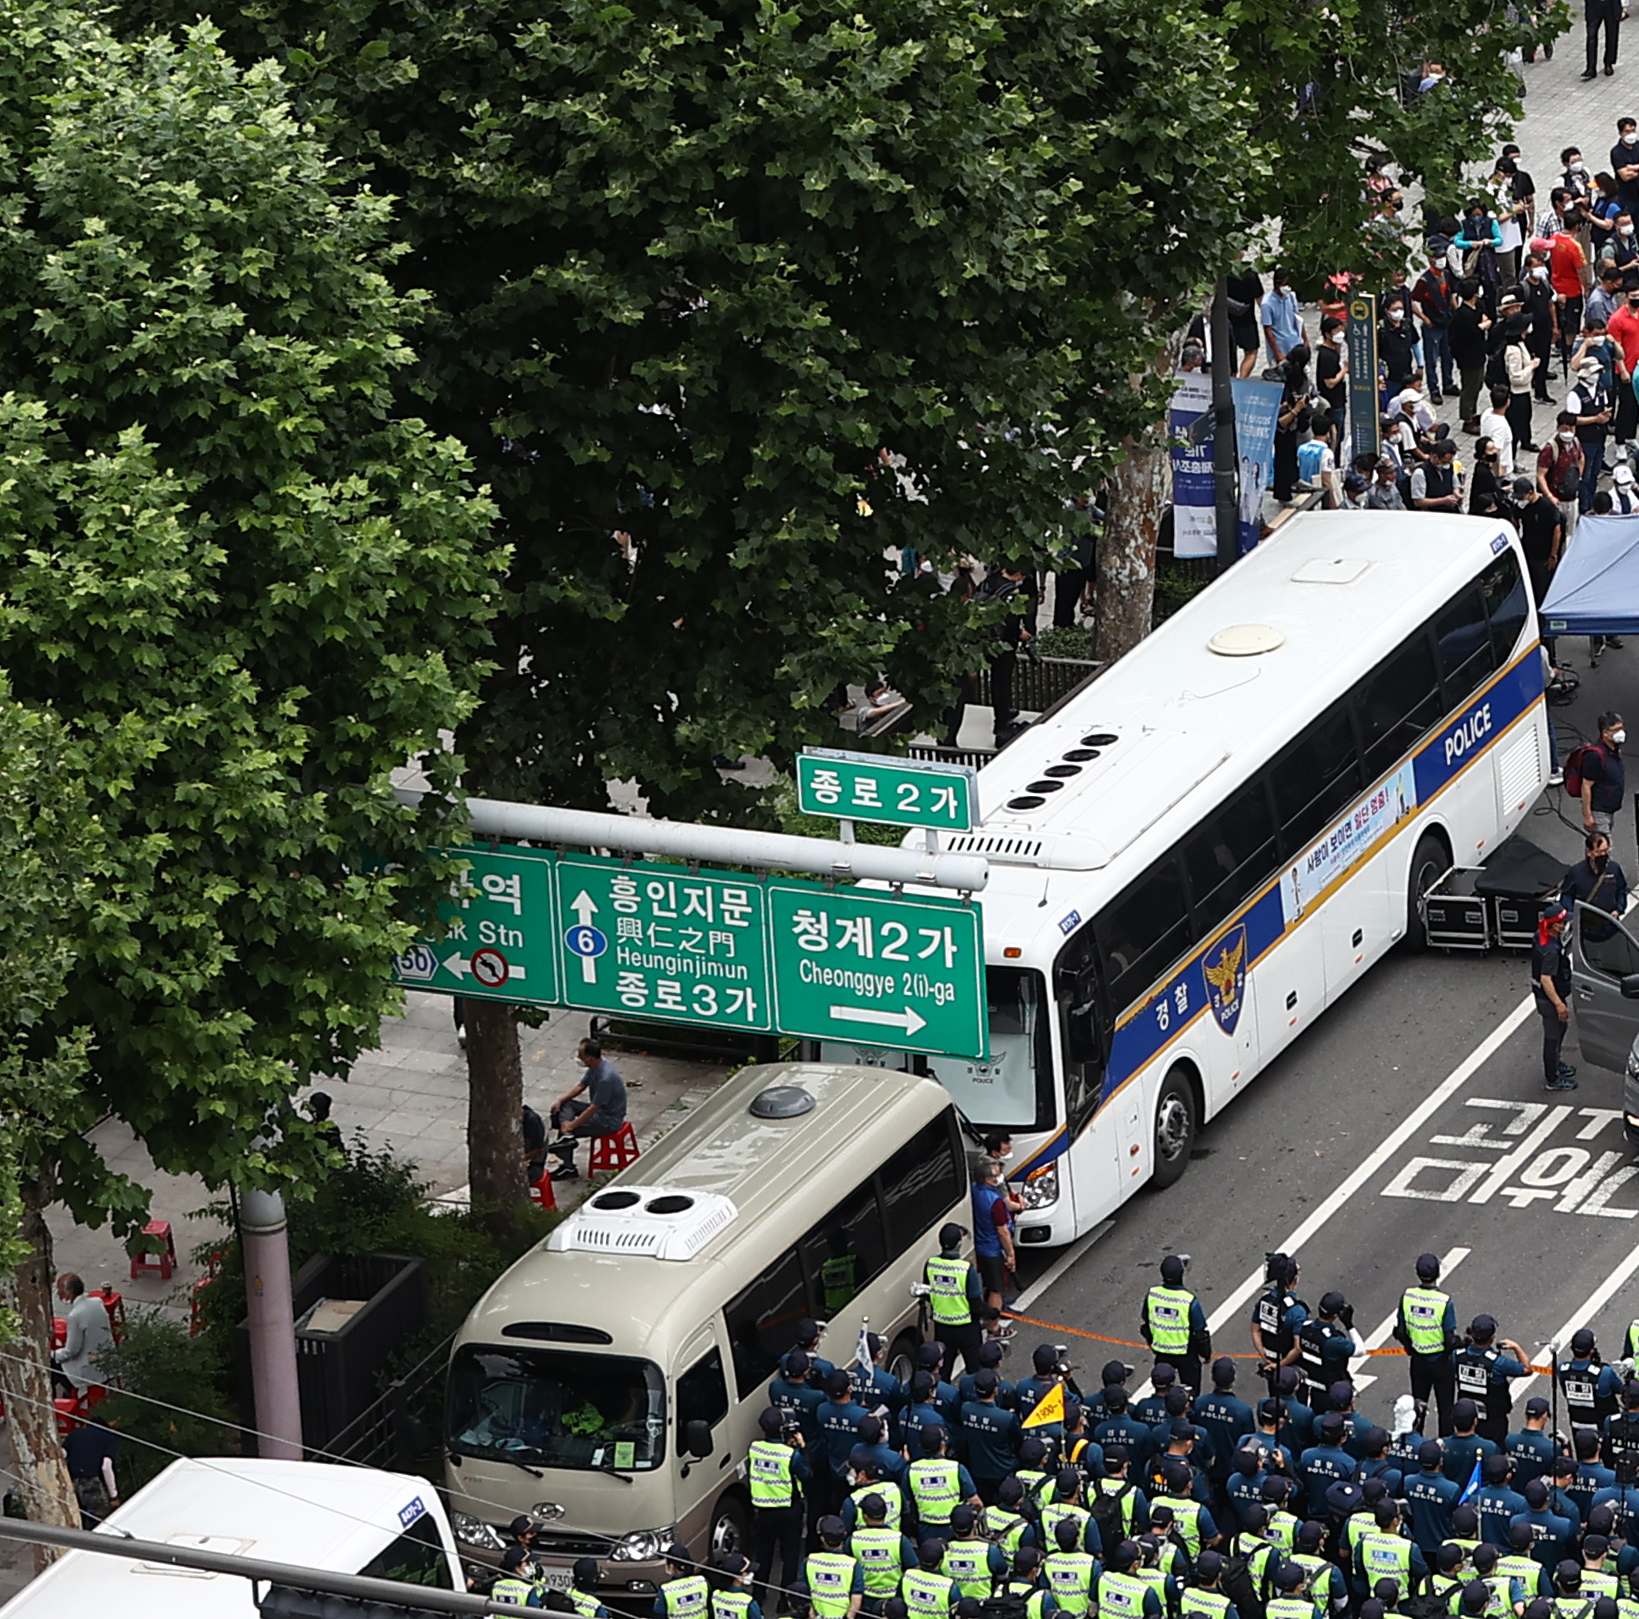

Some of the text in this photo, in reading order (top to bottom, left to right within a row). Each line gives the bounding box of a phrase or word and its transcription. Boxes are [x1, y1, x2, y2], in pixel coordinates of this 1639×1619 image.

[1444, 703, 1493, 766] POLICE
[609, 875, 753, 927] 흥인지문
[478, 921, 524, 949] Stn
[577, 929, 595, 953] 6
[616, 916, 736, 958] 興仁之門
[791, 909, 958, 969] 청계2가
[616, 947, 749, 980] Heunginjimun
[615, 970, 758, 1023] 종로3가
[799, 959, 956, 1006] Cheonggye 2(i)-ga
[1220, 999, 1241, 1024] POLICE
[1302, 1339, 1318, 1352] POLICE
[963, 1420, 998, 1432] POLICE
[1201, 1411, 1234, 1422] POLICE
[1308, 1467, 1339, 1478] POLICE
[1409, 1491, 1443, 1503] POLICE
